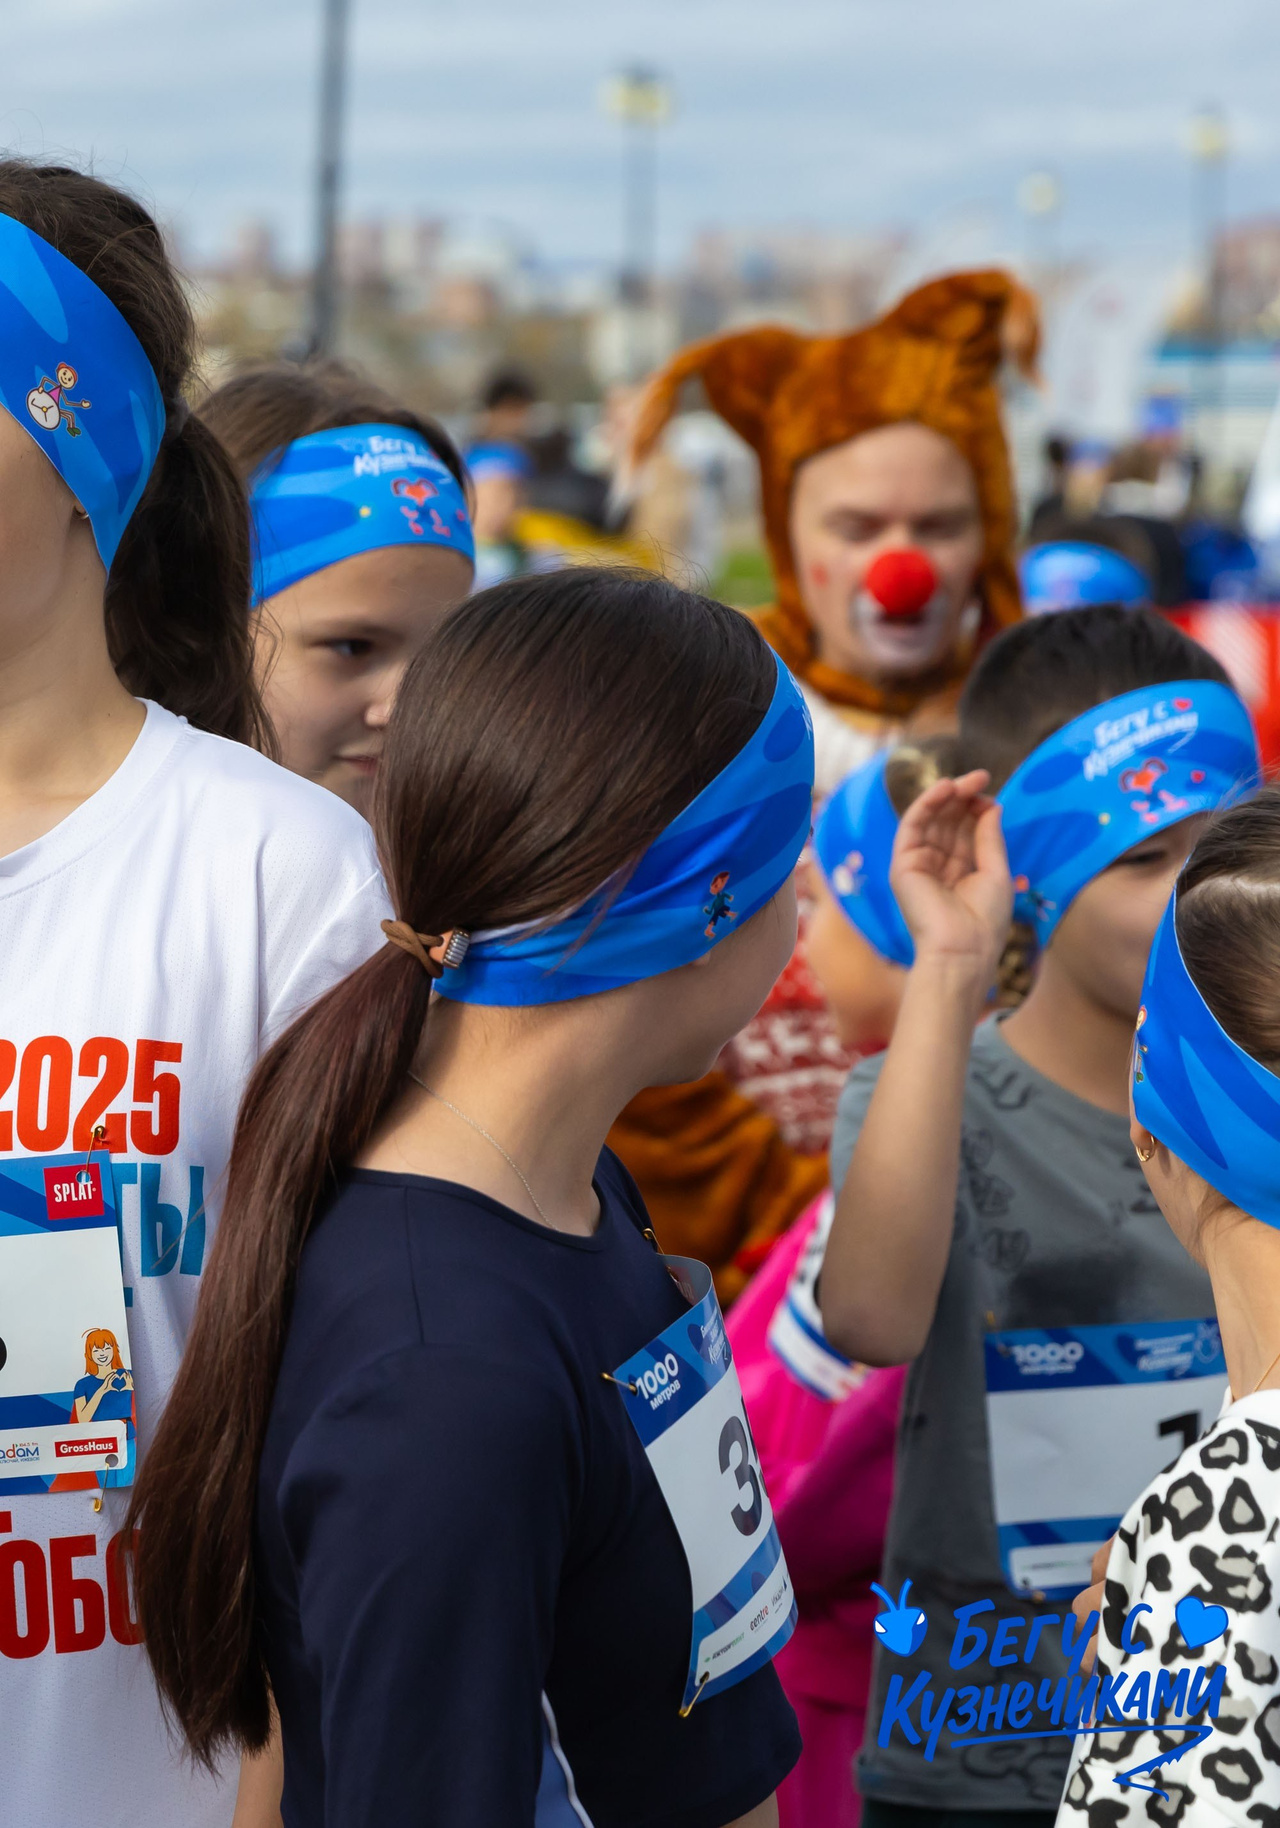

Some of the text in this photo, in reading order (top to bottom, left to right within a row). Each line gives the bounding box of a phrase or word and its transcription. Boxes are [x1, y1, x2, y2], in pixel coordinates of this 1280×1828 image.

[53, 1181, 94, 1204] SPLAT
[636, 1353, 679, 1400] 1000
[649, 1379, 681, 1411] метров
[59, 1441, 114, 1454] GrossHaus
[718, 1395, 772, 1537] 3
